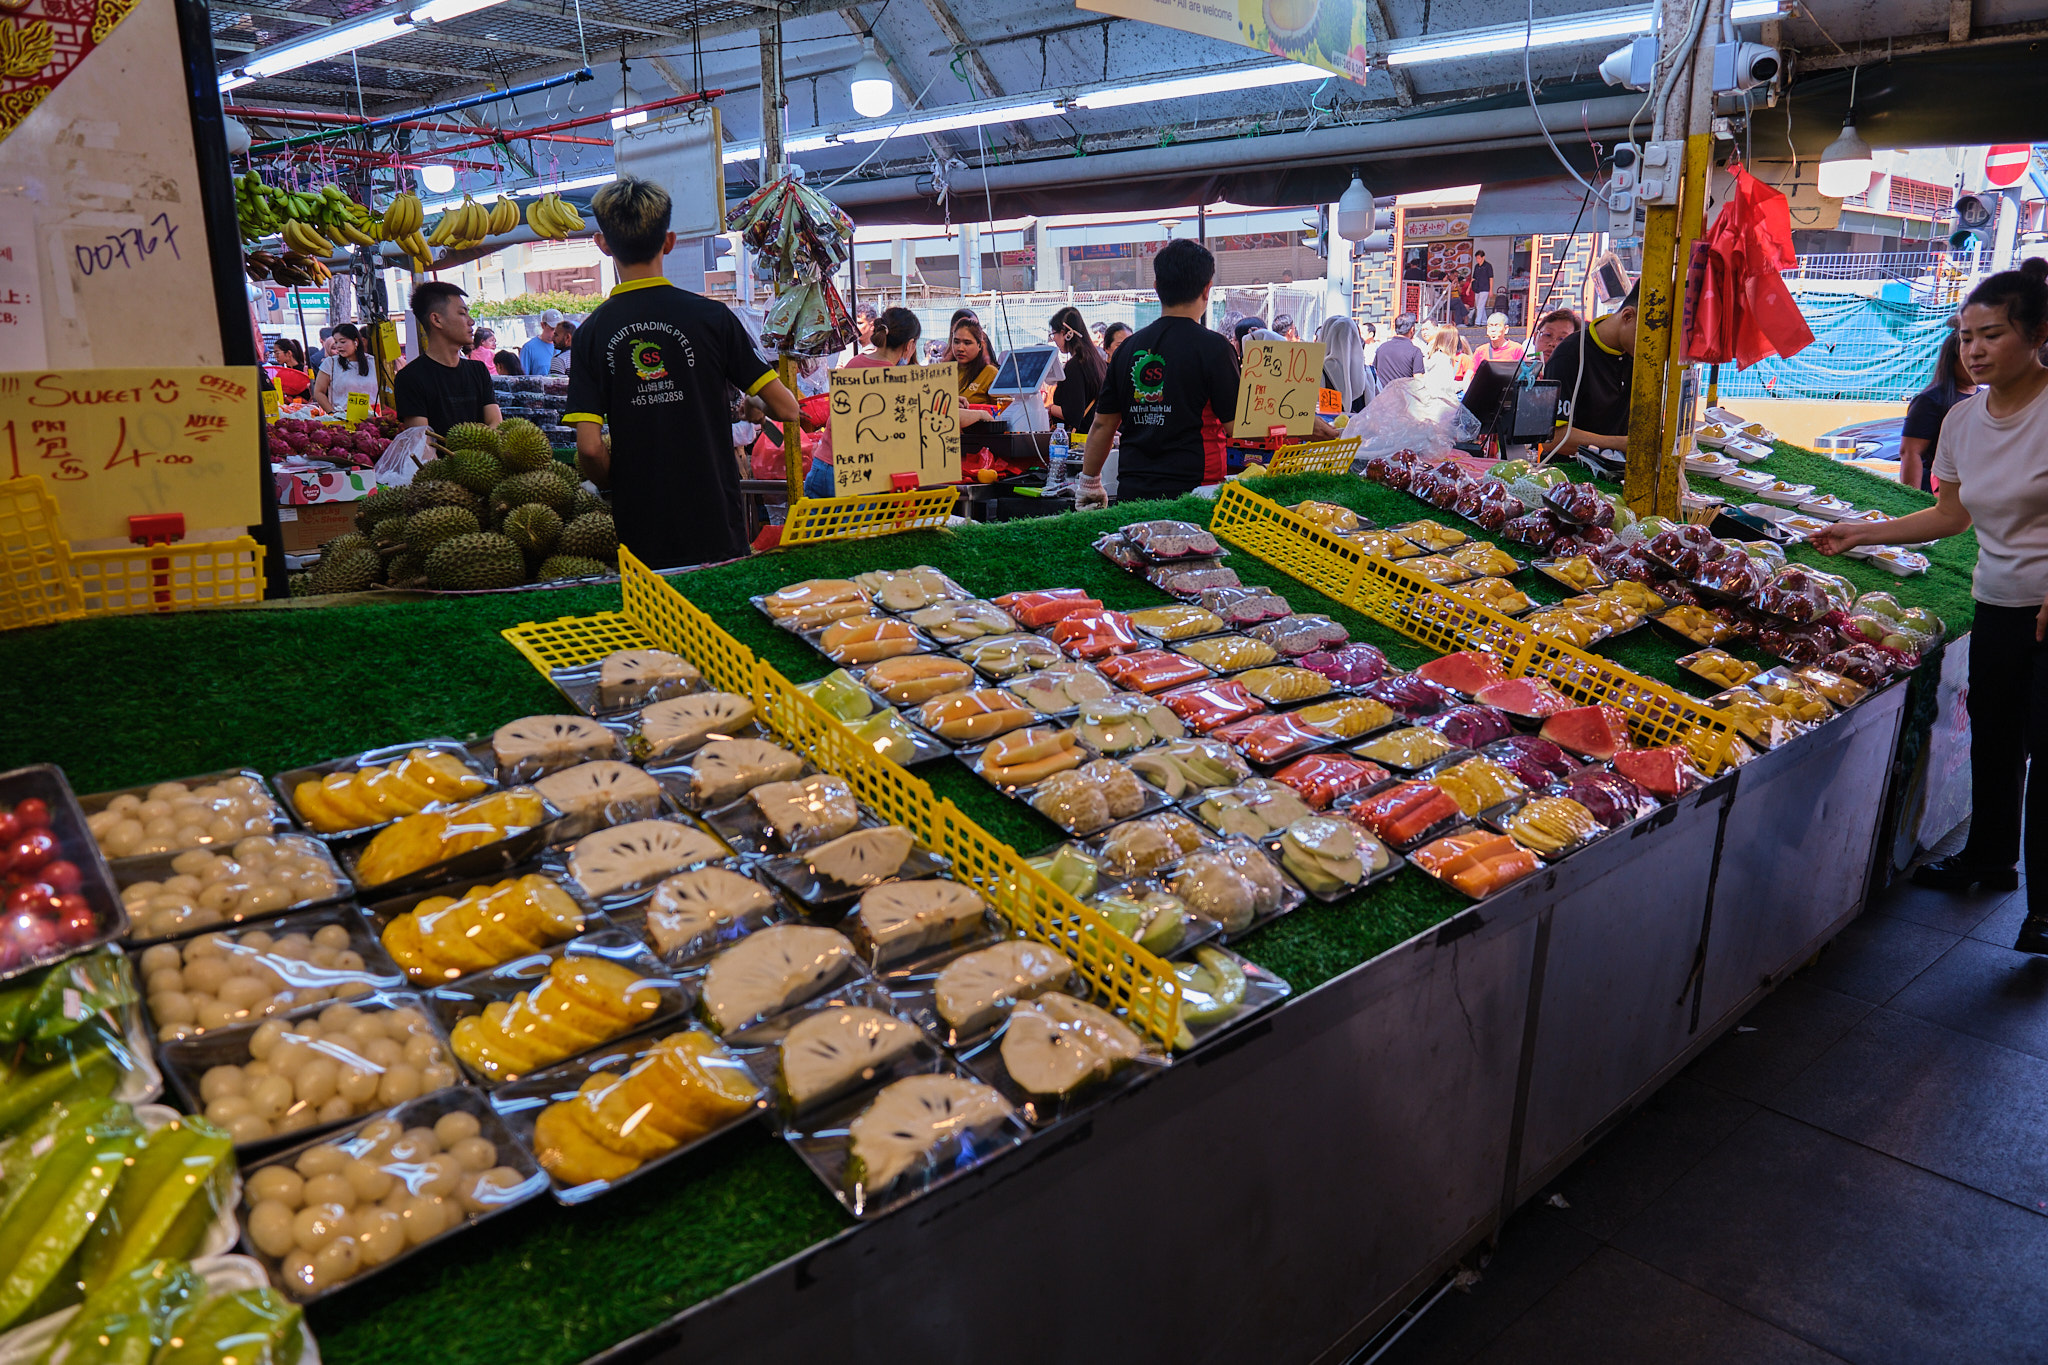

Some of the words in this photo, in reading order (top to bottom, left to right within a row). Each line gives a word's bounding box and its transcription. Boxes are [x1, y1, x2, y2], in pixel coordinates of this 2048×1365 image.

[1188, 1, 1201, 12] are
[1202, 4, 1233, 21] welcome
[75, 212, 181, 276] 007767
[291, 296, 321, 305] Bncoolen
[607, 326, 630, 350] FRUIT
[629, 321, 674, 334] TRADING
[672, 328, 690, 348] PTE
[684, 347, 695, 368] LTD
[642, 351, 661, 364] SS
[1244, 347, 1263, 379] 2
[830, 370, 860, 386] FRESH
[862, 369, 880, 385] CUT
[883, 368, 908, 383] FRUIT
[1144, 367, 1163, 380] SS
[200, 375, 248, 399] OFFER
[631, 395, 647, 406] +65
[1241, 384, 1252, 426] 1
[1254, 384, 1266, 395] PKT
[836, 454, 855, 464] PER
[858, 453, 874, 464] PKT
[312, 506, 340, 515] Lucky
[321, 516, 349, 524] Sheep
